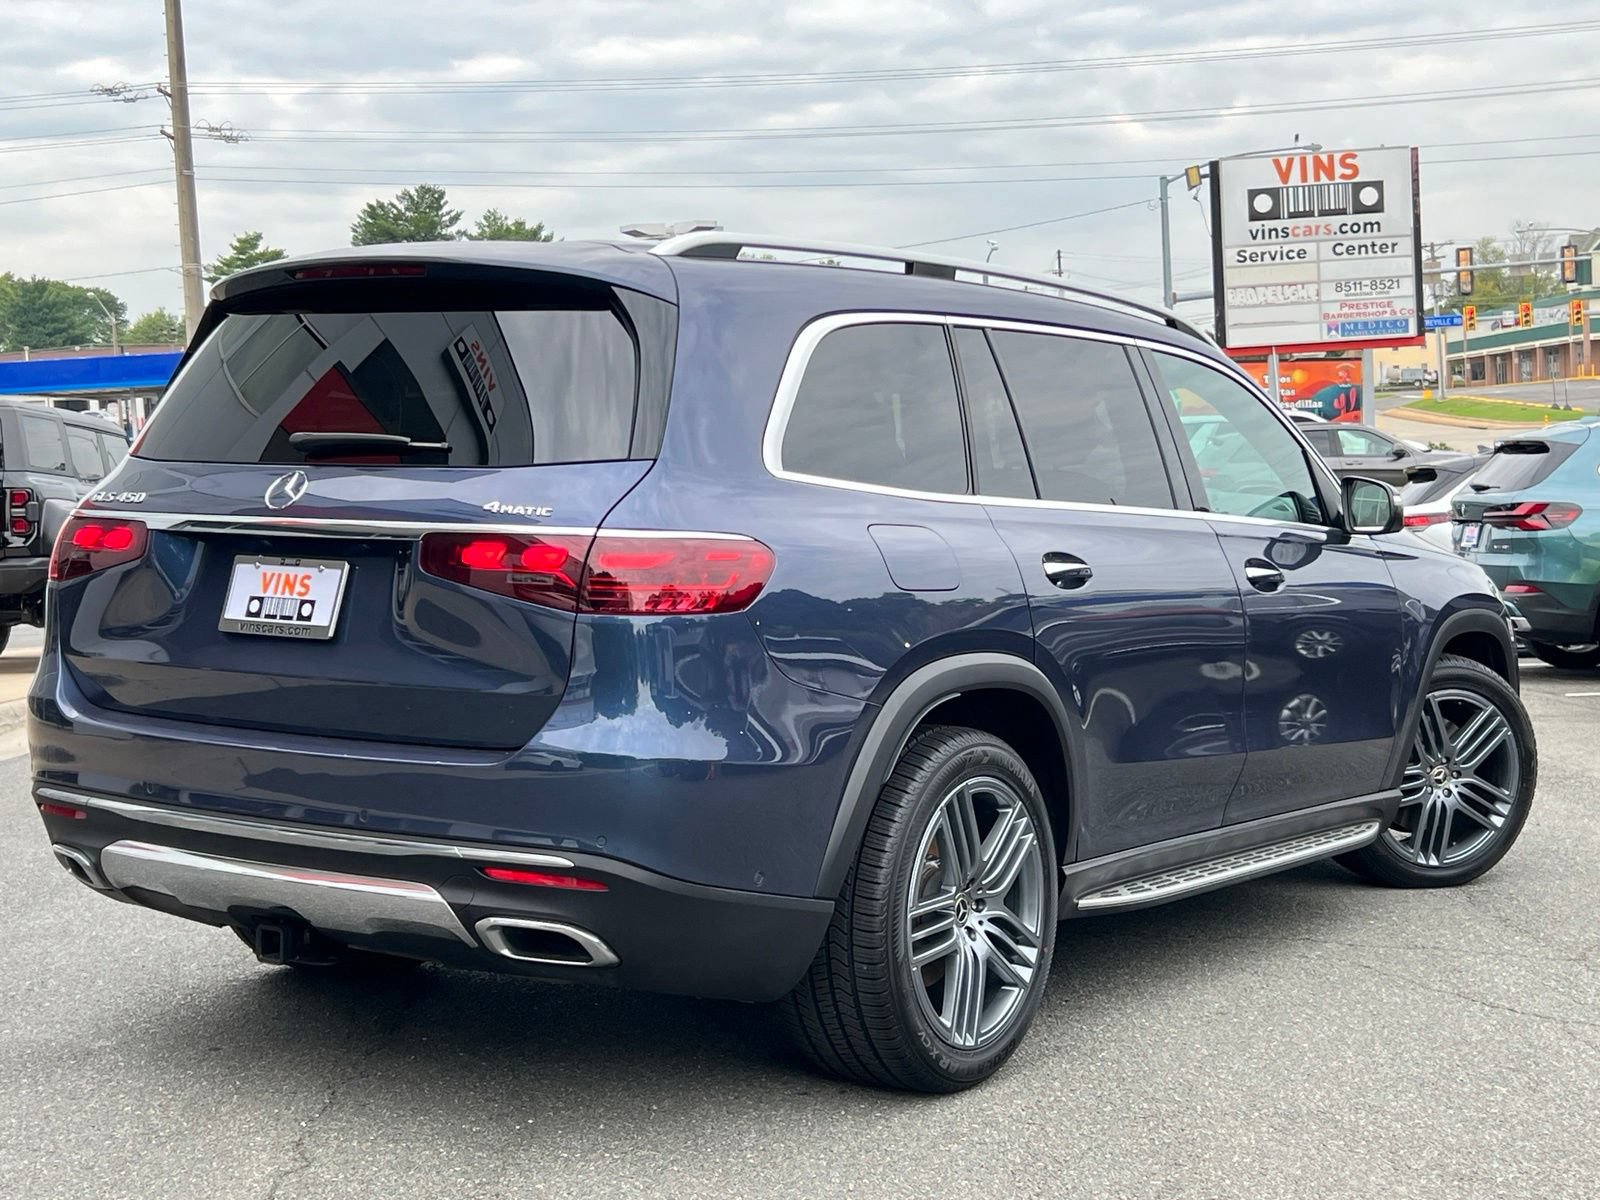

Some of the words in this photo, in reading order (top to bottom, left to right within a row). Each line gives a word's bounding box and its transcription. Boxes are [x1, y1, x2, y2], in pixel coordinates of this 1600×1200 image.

[1272, 152, 1360, 185] VINS
[1249, 220, 1381, 241] vinscars.com
[1236, 246, 1307, 264] Service
[1332, 240, 1398, 257] Center
[1335, 279, 1400, 293] 8511-8521
[1340, 301, 1393, 311] PRESTIGE
[1322, 310, 1388, 320] BARBERSHOP
[1344, 320, 1406, 331] MEDICO
[1263, 375, 1291, 384] Tos
[1279, 400, 1323, 409] esadillas
[92, 491, 117, 502] GLS
[116, 491, 147, 504] 450
[483, 501, 553, 517] 4MATIC
[262, 572, 312, 597] VINS
[239, 622, 312, 636] vinscars.com
